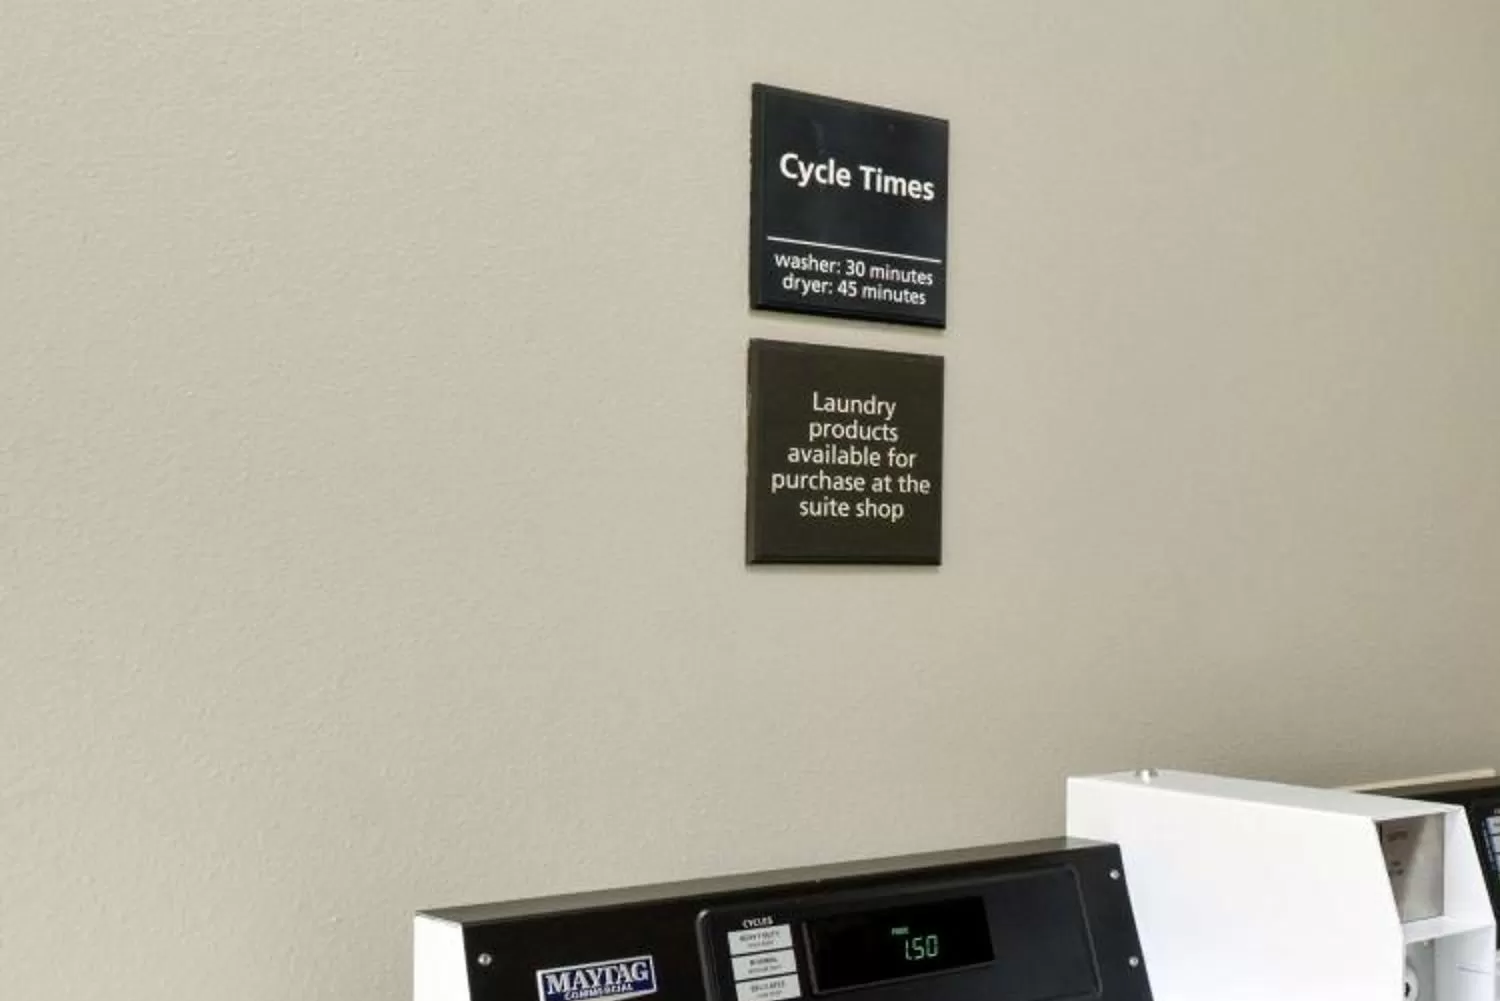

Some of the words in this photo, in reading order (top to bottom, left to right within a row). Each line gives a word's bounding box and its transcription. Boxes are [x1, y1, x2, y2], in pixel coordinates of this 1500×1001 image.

[779, 153, 851, 187] Cycle
[859, 165, 935, 200] Times
[773, 253, 841, 274] washer:
[846, 259, 865, 277] 30
[870, 264, 933, 286] minutes
[782, 273, 833, 297] dryer:
[837, 280, 857, 297] 45
[861, 284, 926, 305] minutes
[812, 391, 897, 421] Laundry
[808, 420, 899, 442] products
[787, 444, 881, 467] available
[888, 447, 917, 468] for
[771, 469, 866, 493] purchase
[871, 475, 892, 493] at
[898, 474, 931, 494] the
[799, 496, 850, 516] suite
[855, 498, 904, 523] shop
[545, 961, 649, 995] MAYTAG
